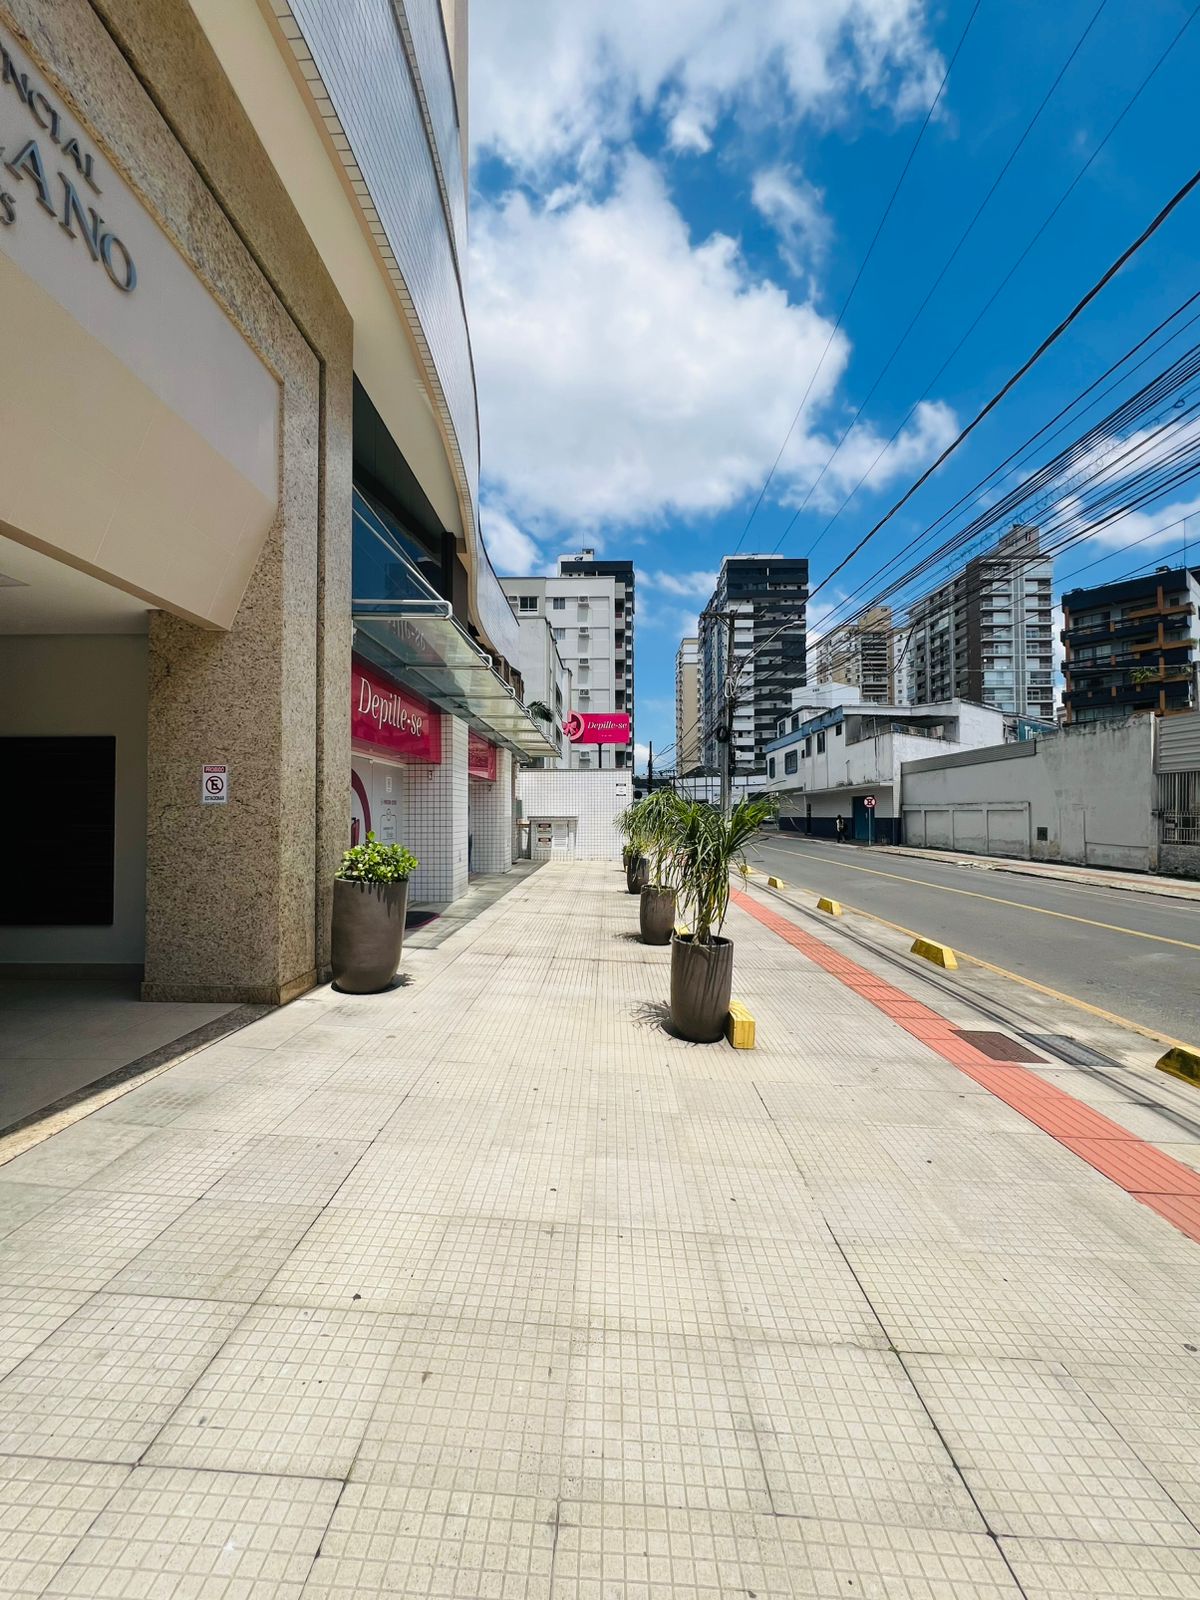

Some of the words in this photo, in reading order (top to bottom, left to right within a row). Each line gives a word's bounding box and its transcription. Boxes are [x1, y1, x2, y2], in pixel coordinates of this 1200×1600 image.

[0, 139, 137, 292] ANO
[358, 677, 423, 737] Depille-se
[587, 720, 628, 731] Depille-se
